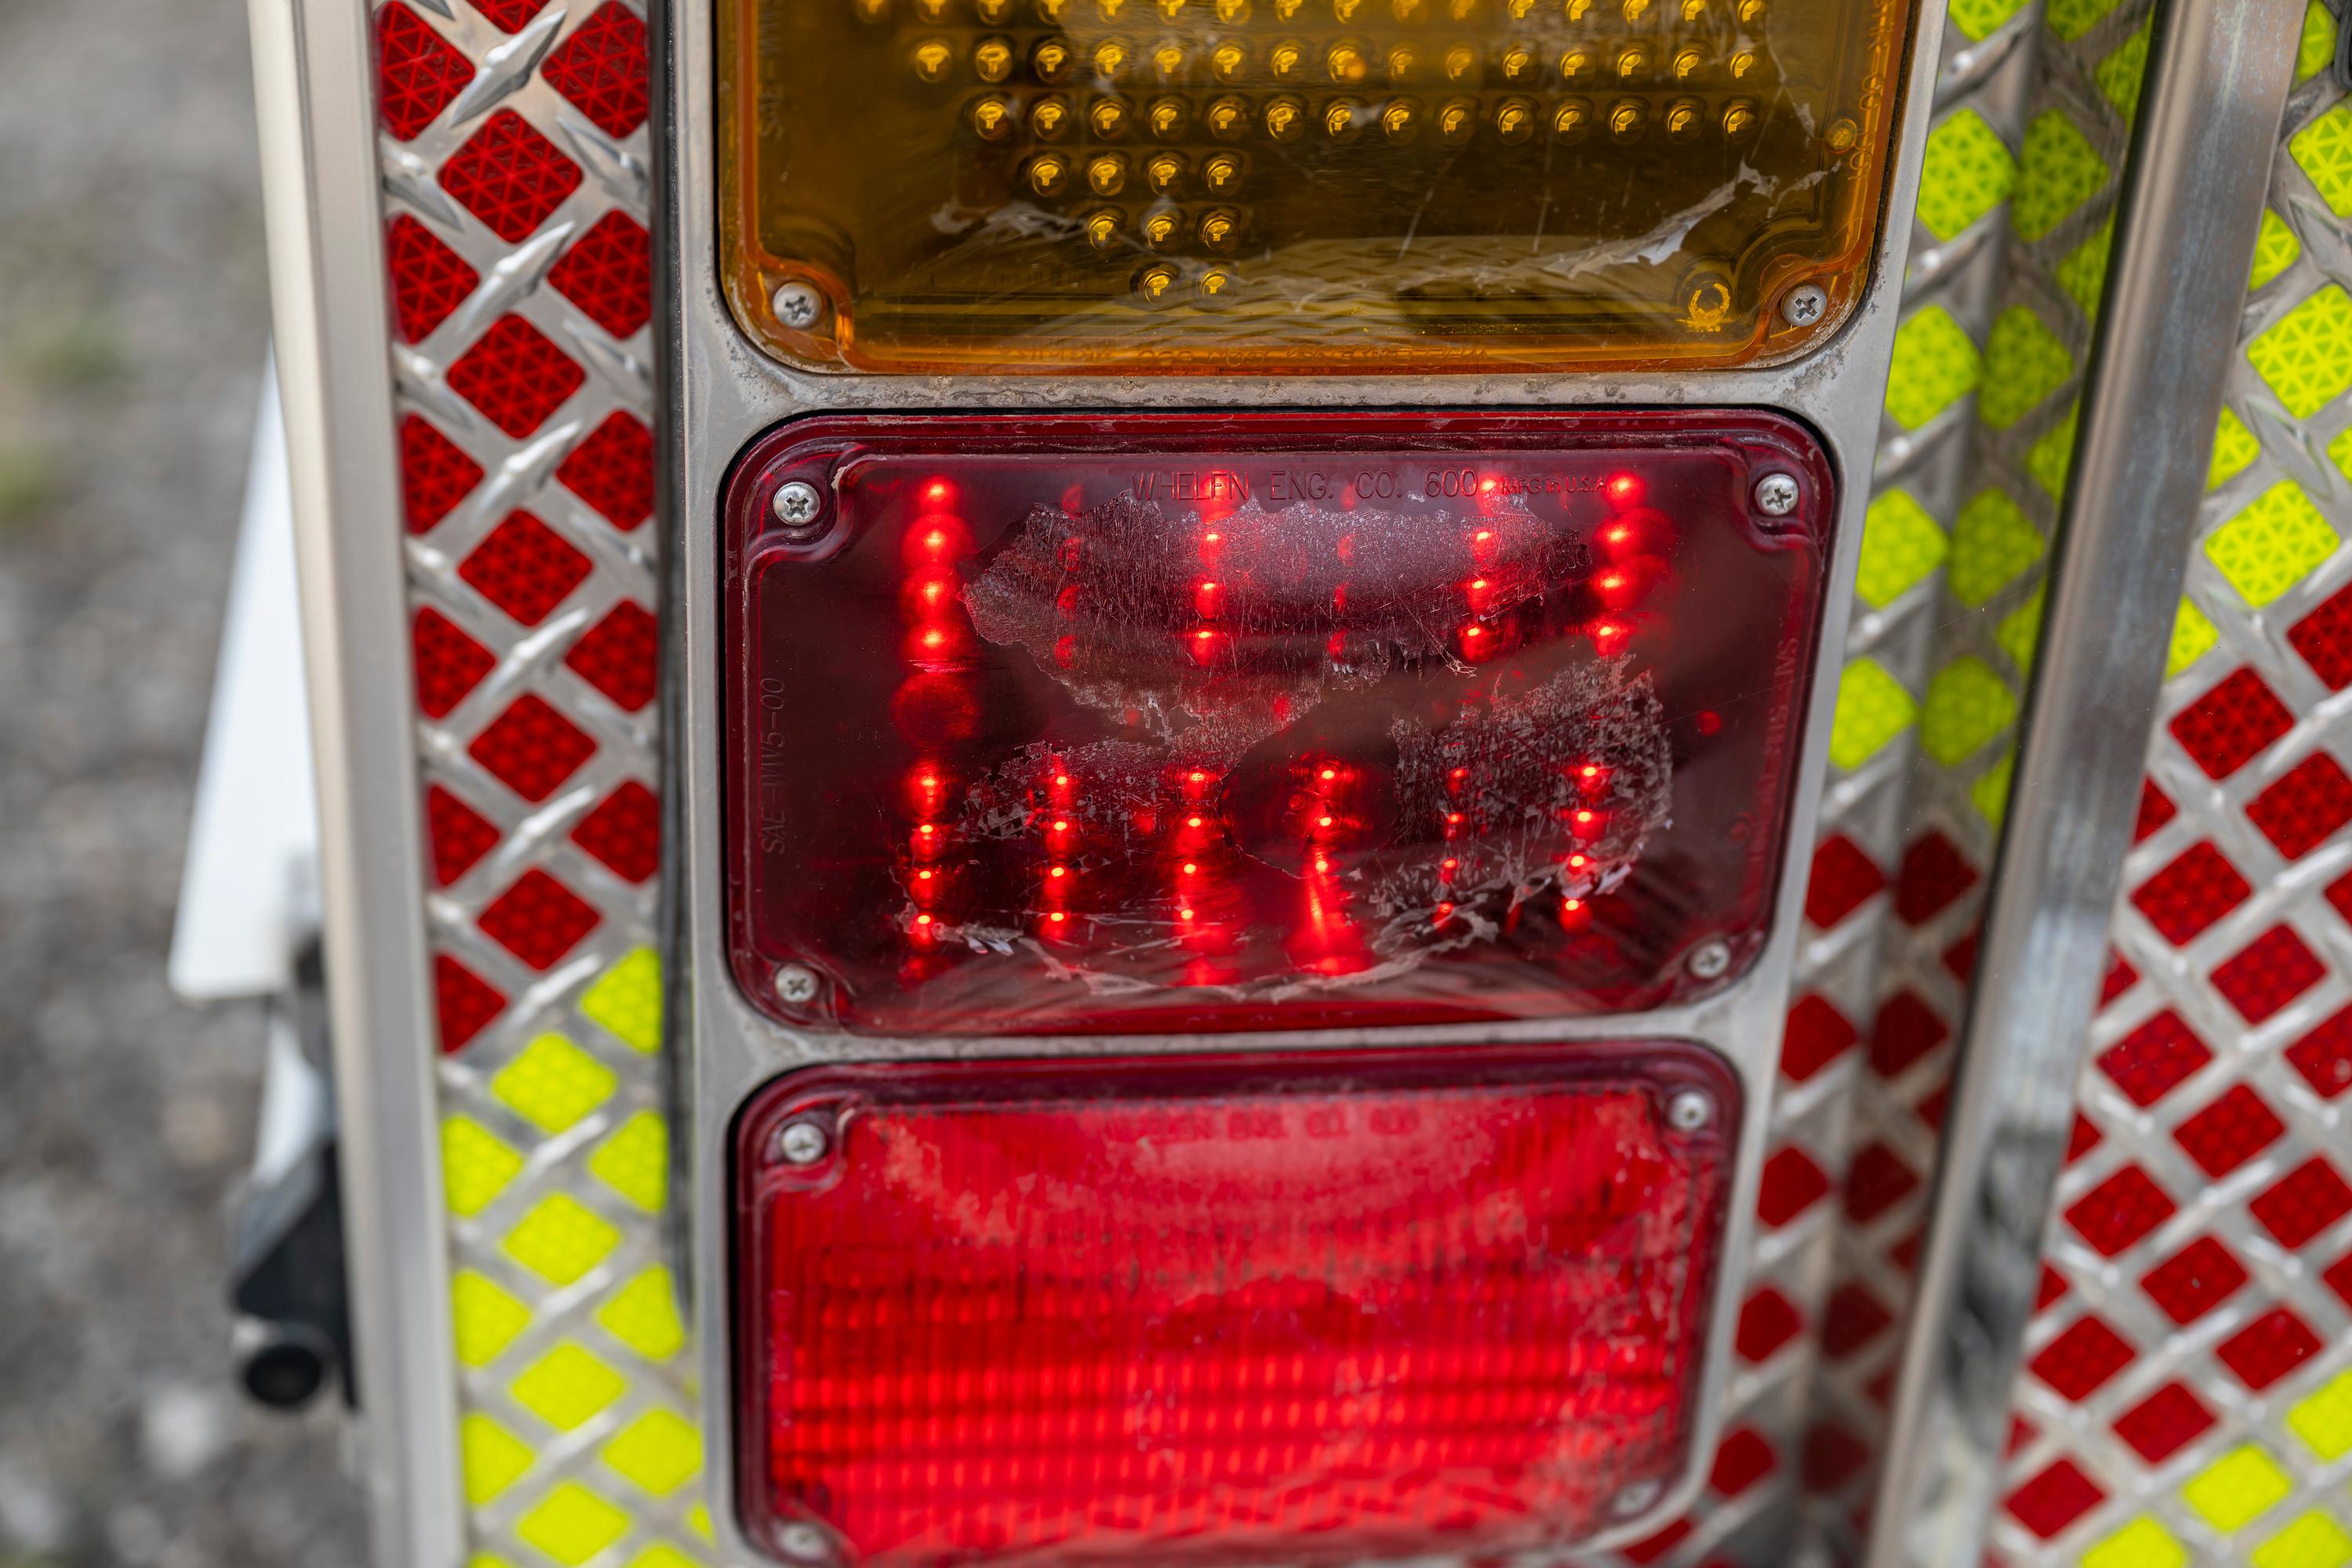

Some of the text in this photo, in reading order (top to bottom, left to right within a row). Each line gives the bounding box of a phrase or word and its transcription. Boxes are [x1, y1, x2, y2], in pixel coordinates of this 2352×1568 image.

[1131, 470, 1249, 500] WHELEN
[1269, 470, 1334, 500] ENG.
[1354, 470, 1403, 499] CO.
[1425, 469, 1479, 498] 600
[1500, 475, 1542, 495] MFG
[1546, 477, 1561, 494] in
